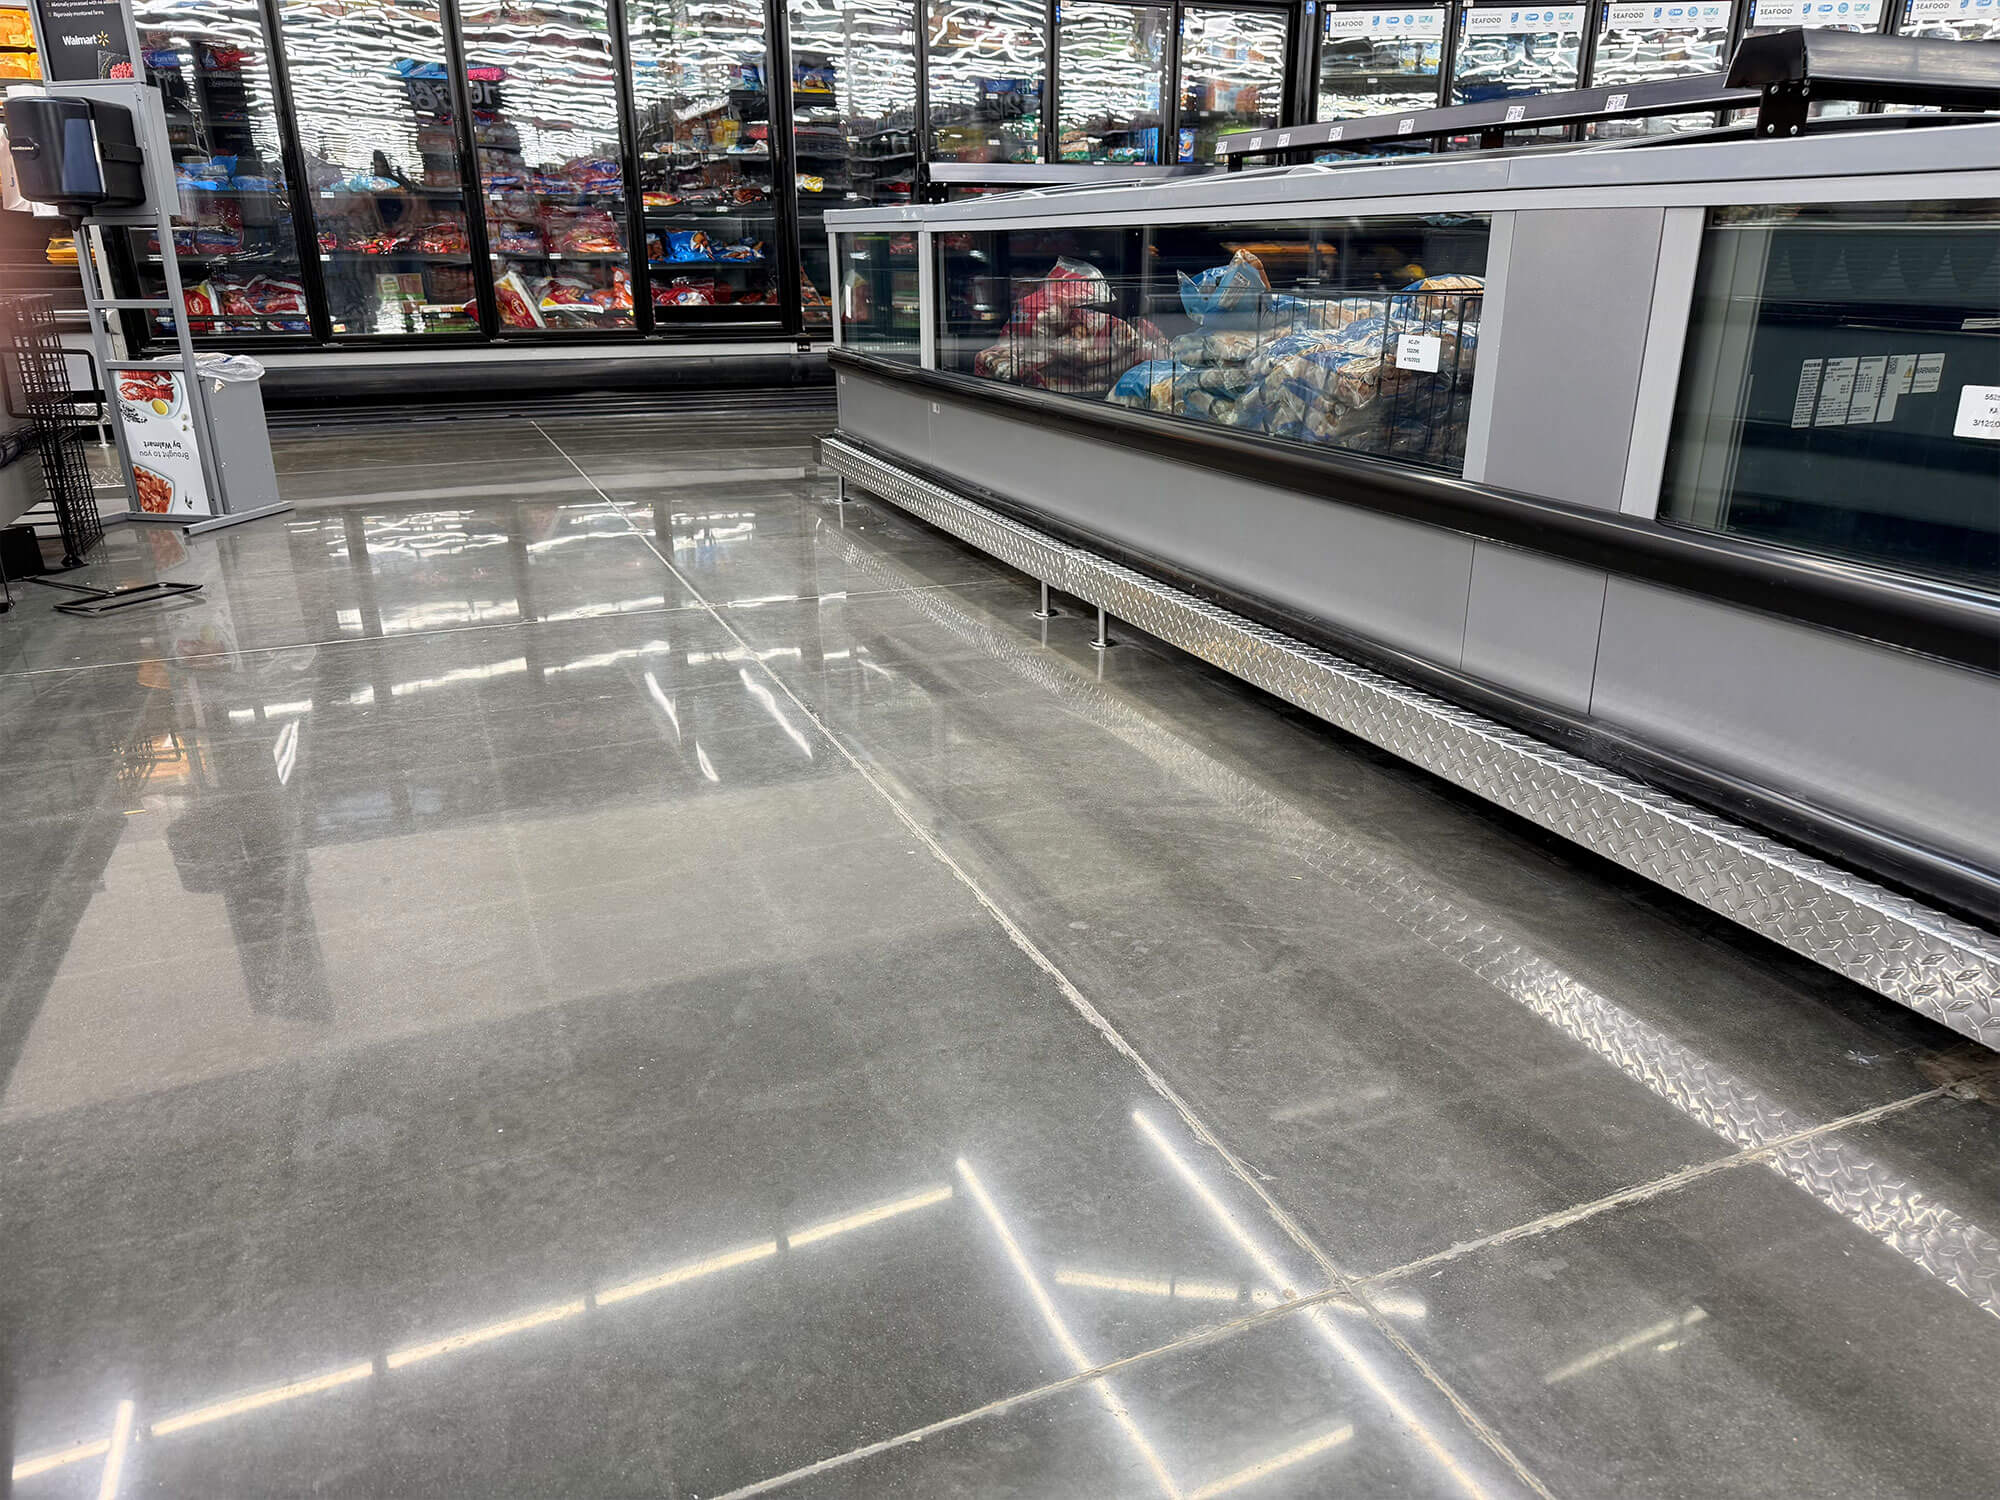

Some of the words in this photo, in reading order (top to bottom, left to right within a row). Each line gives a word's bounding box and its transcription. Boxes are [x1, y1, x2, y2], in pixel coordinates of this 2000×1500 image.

[1916, 2, 1950, 10] SEAFOOD
[1760, 8, 1793, 16] SEAFOOD
[1334, 20, 1364, 28] SEAFOOD
[62, 34, 98, 46] Walmart
[143, 440, 173, 449] Walmart
[172, 441, 182, 449] by
[139, 449, 152, 457] you
[153, 450, 161, 458] to
[163, 450, 190, 460] Brought
